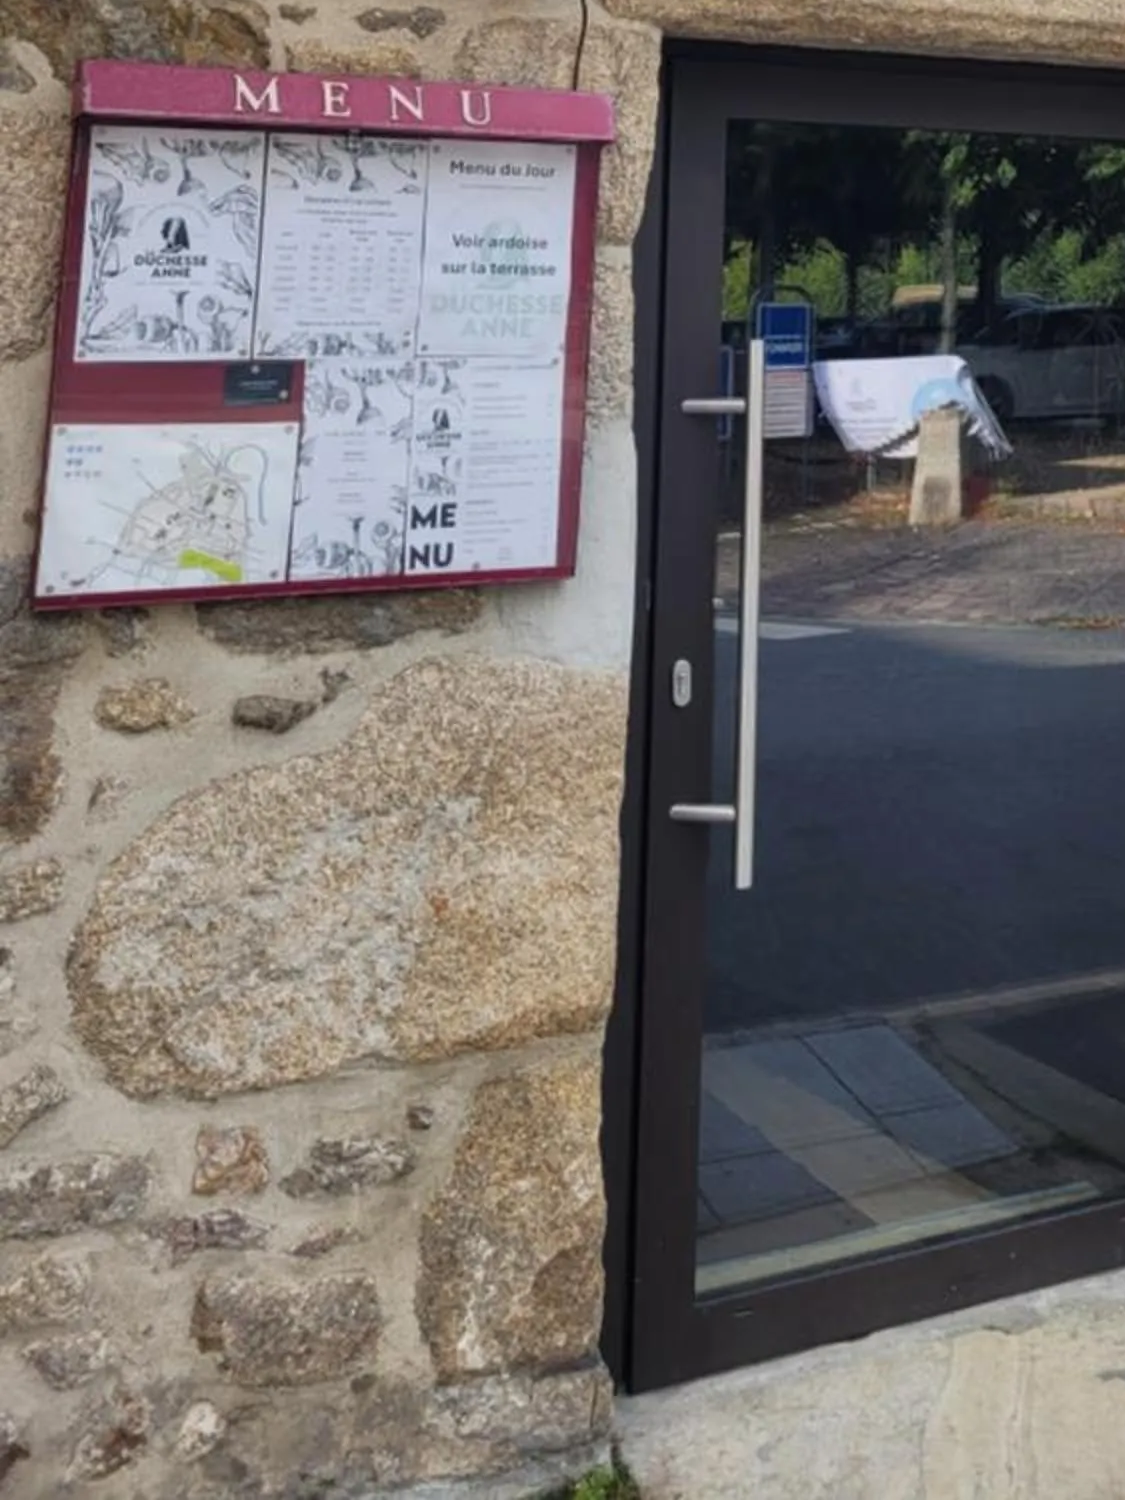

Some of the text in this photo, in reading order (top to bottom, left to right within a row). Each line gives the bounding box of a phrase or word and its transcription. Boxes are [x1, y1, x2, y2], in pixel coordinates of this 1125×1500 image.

[233, 75, 493, 127] MENU
[450, 160, 496, 177] Menu
[500, 163, 522, 177] du
[411, 503, 457, 530] ME
[409, 543, 454, 570] NU
